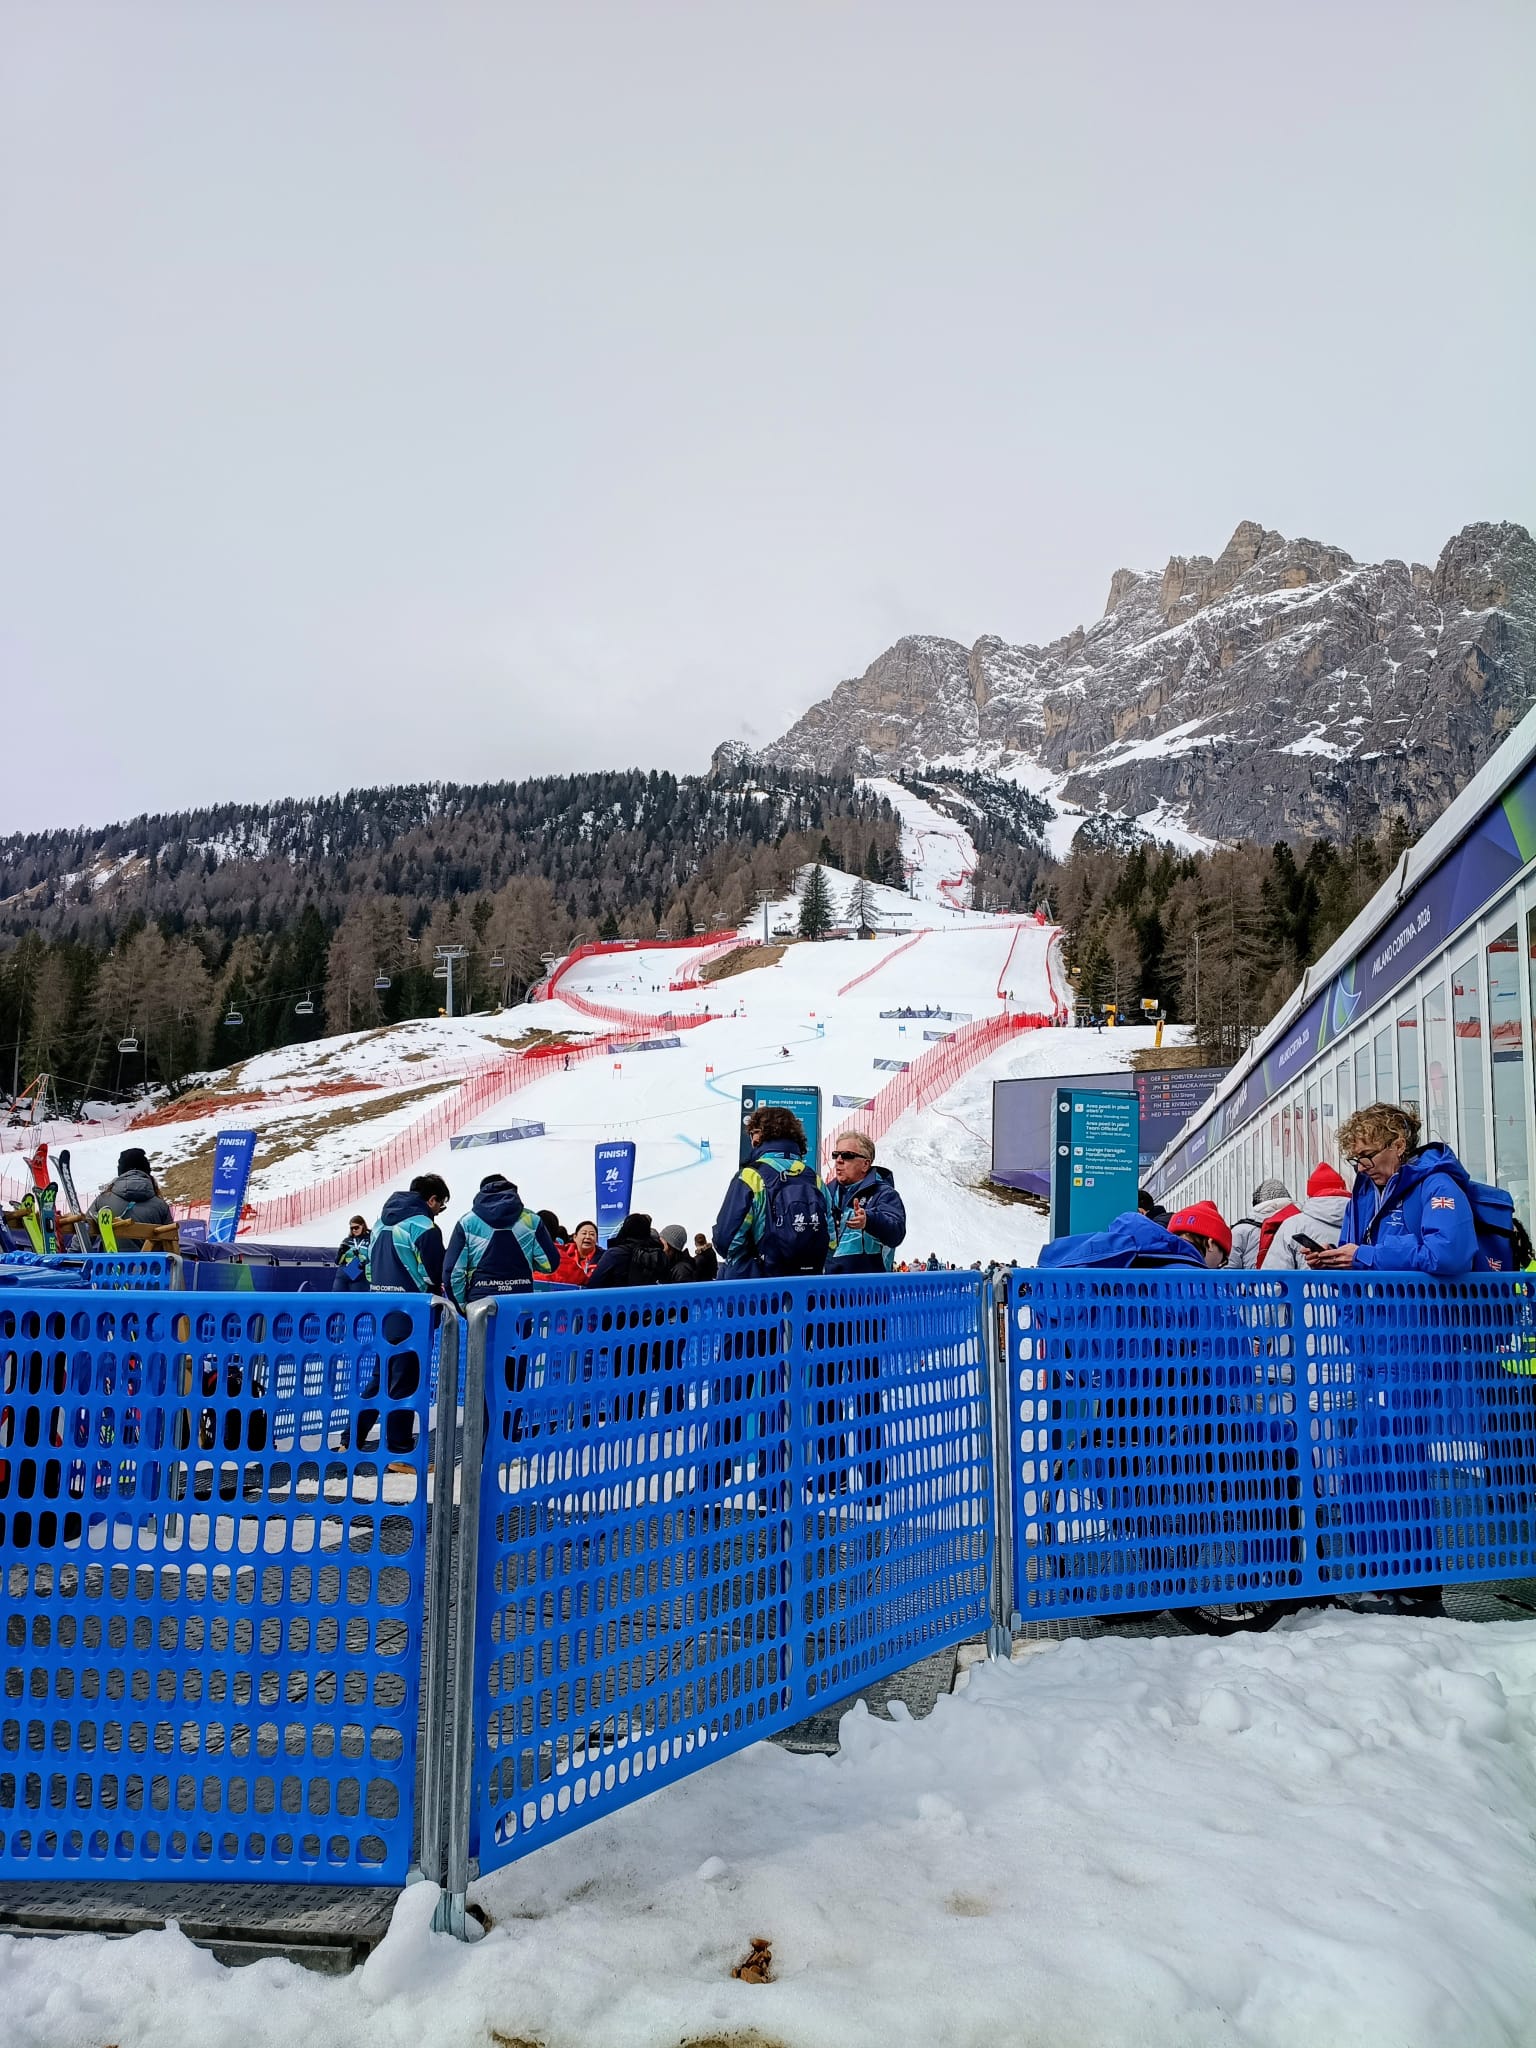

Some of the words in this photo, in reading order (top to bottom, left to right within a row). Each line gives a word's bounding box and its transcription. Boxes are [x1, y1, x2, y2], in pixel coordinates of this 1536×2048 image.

[1371, 944, 1393, 979] MILANO
[1392, 922, 1417, 956] CORTINA
[1417, 904, 1431, 932] 2026
[219, 1138, 247, 1146] FINISH
[598, 1149, 628, 1160] FINISH
[504, 1278, 532, 1286] CORTINA
